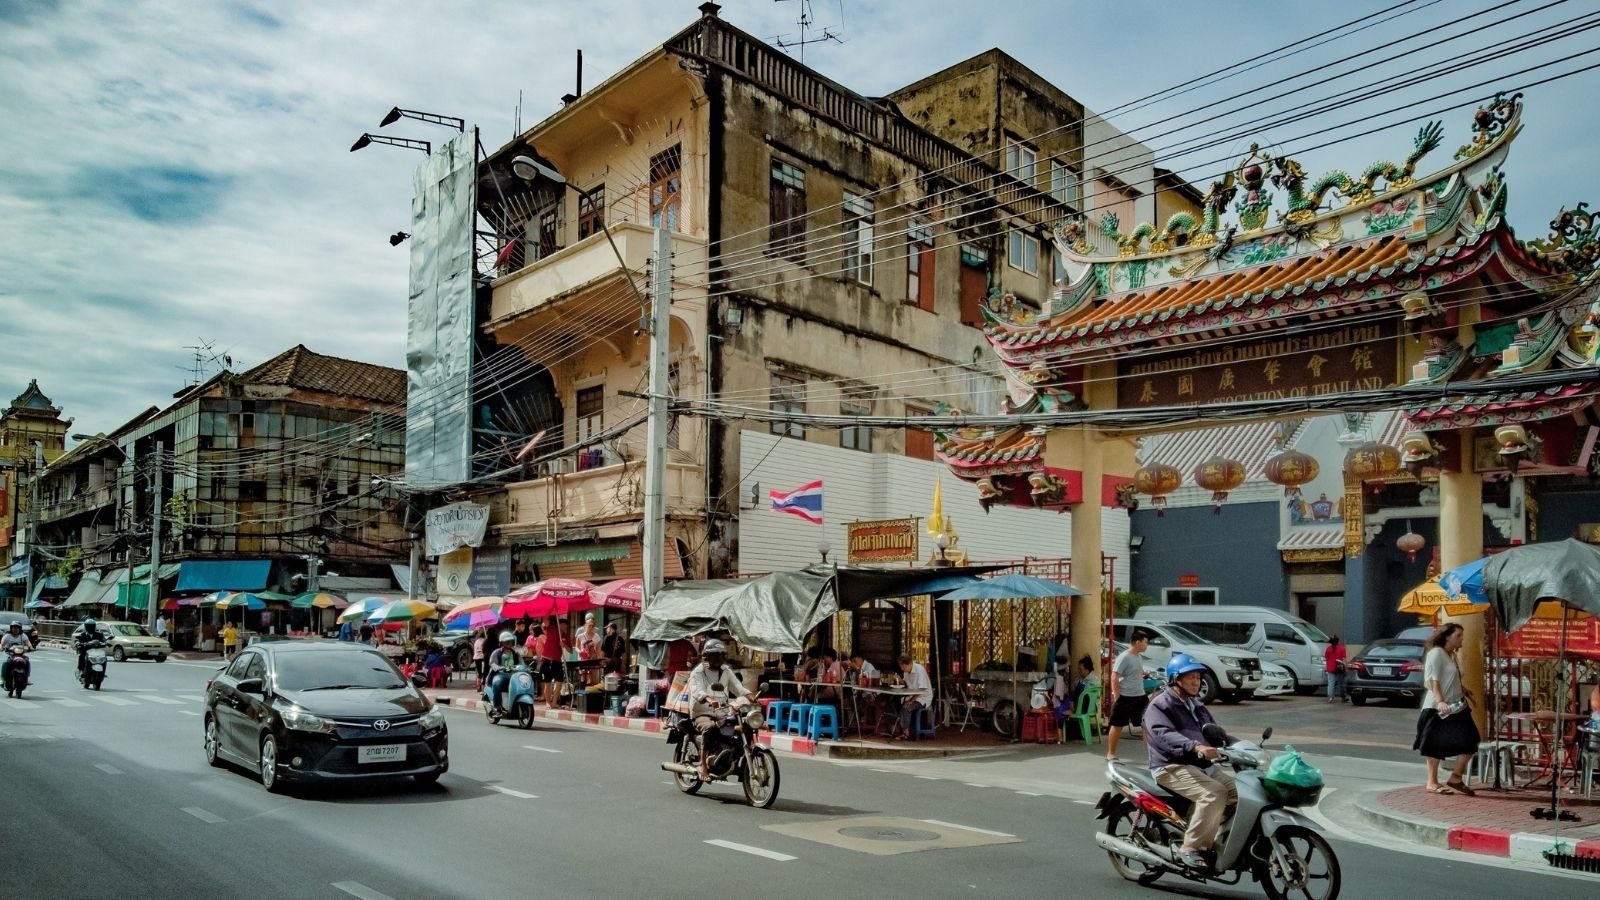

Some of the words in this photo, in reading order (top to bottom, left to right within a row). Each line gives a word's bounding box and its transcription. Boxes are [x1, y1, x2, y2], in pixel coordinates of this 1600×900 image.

[1207, 389, 1285, 404] OCIATION
[1290, 386, 1308, 398] OF
[1312, 376, 1382, 396] THAILAND
[1421, 592, 1466, 602] honesbe
[622, 599, 633, 607] 252
